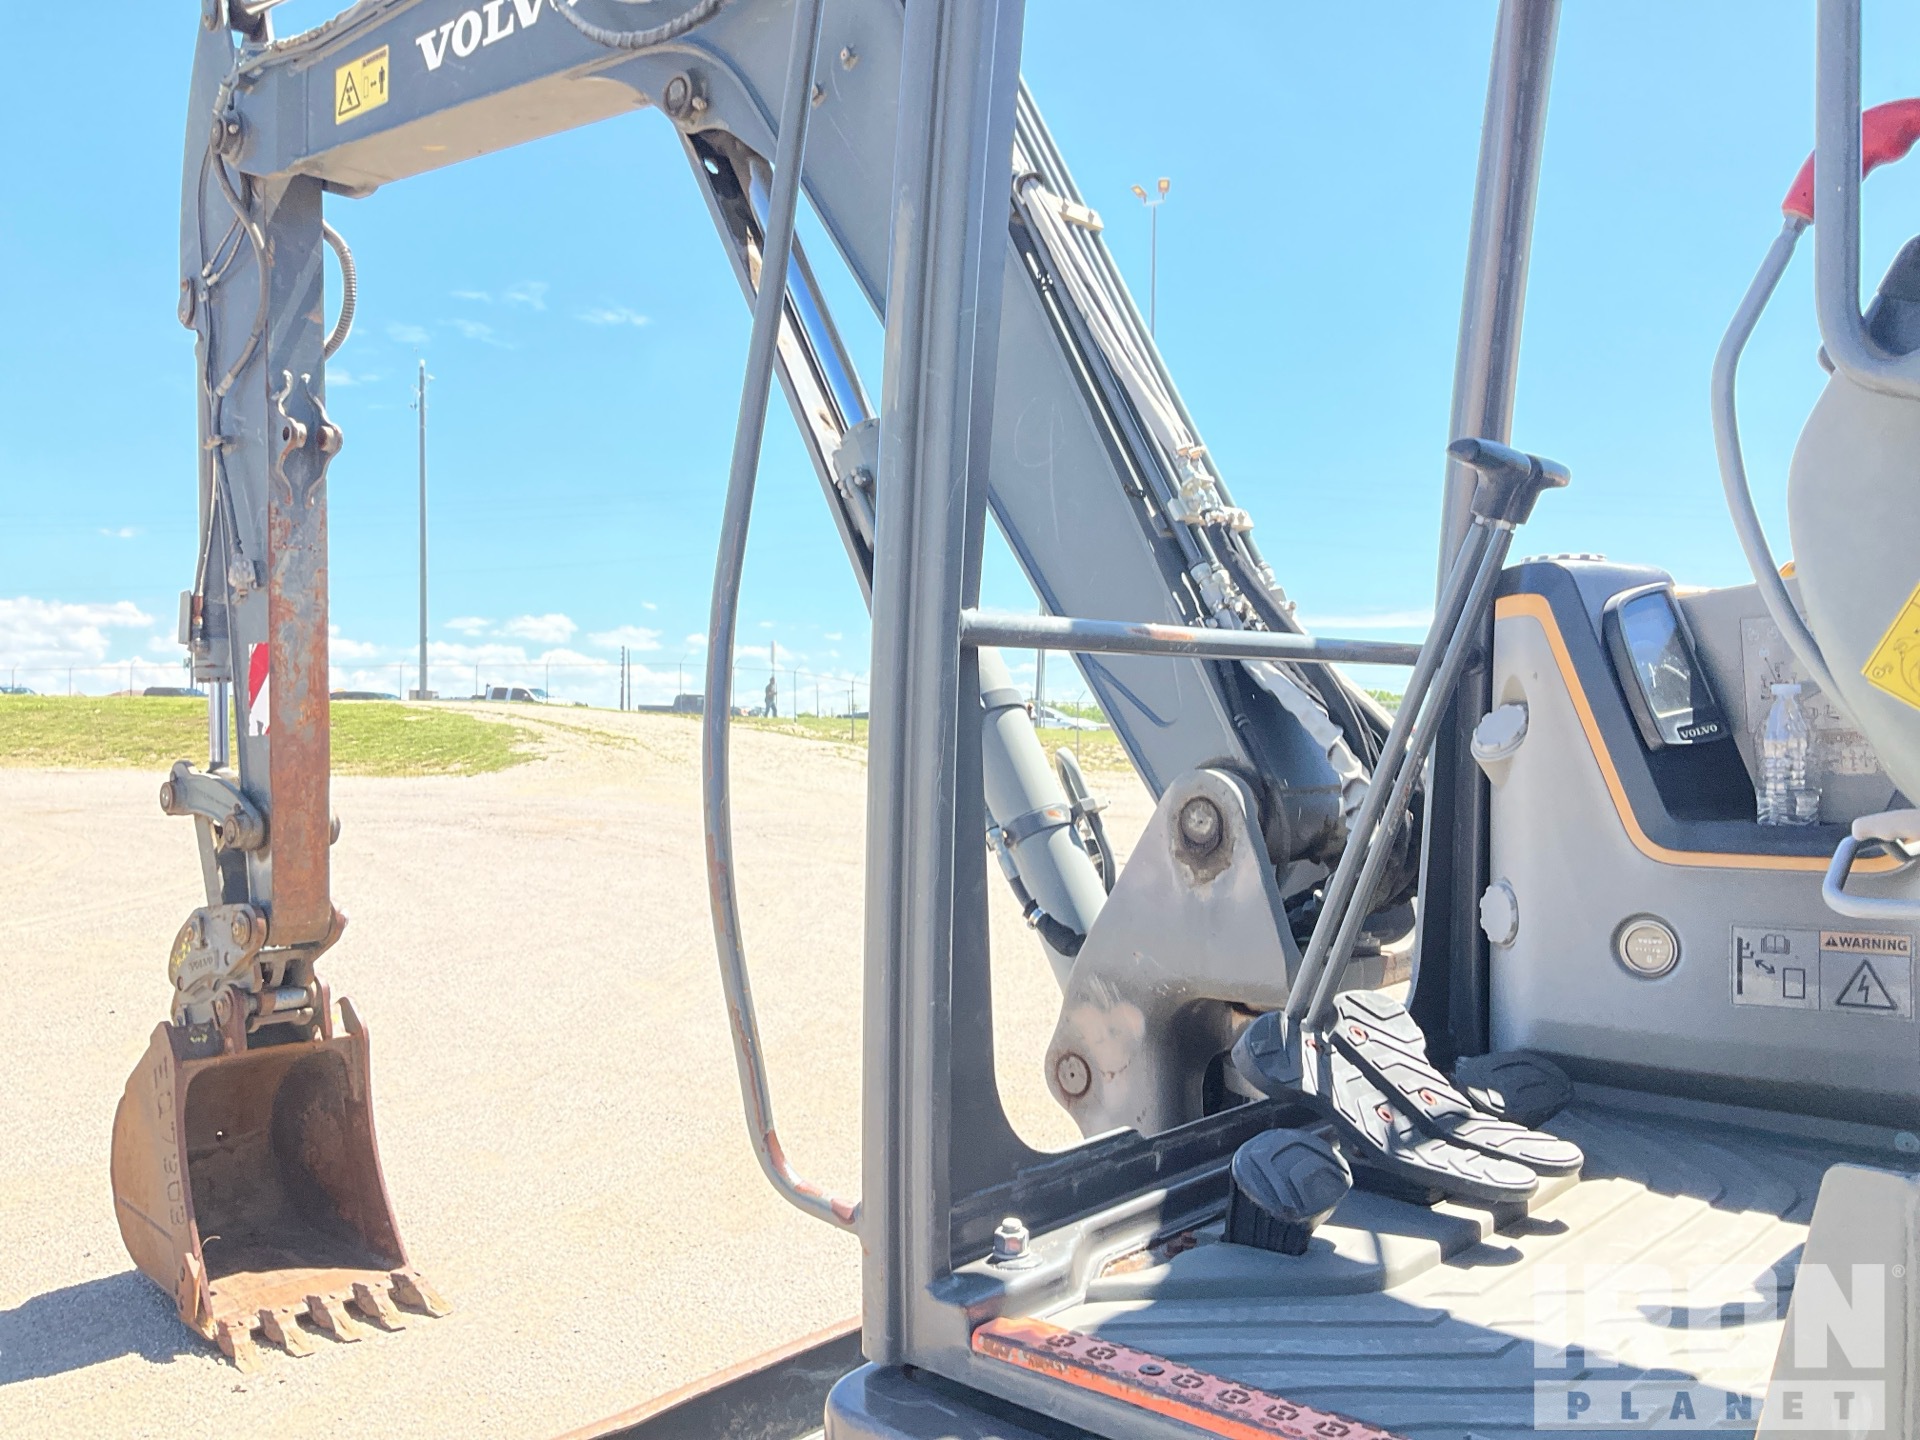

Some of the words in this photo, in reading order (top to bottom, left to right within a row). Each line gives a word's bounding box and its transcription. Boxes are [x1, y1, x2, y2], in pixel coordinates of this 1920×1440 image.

[415, 0, 578, 71] VOLV
[1680, 723, 1718, 739] VOLVO
[1838, 936, 1908, 951] WARNING
